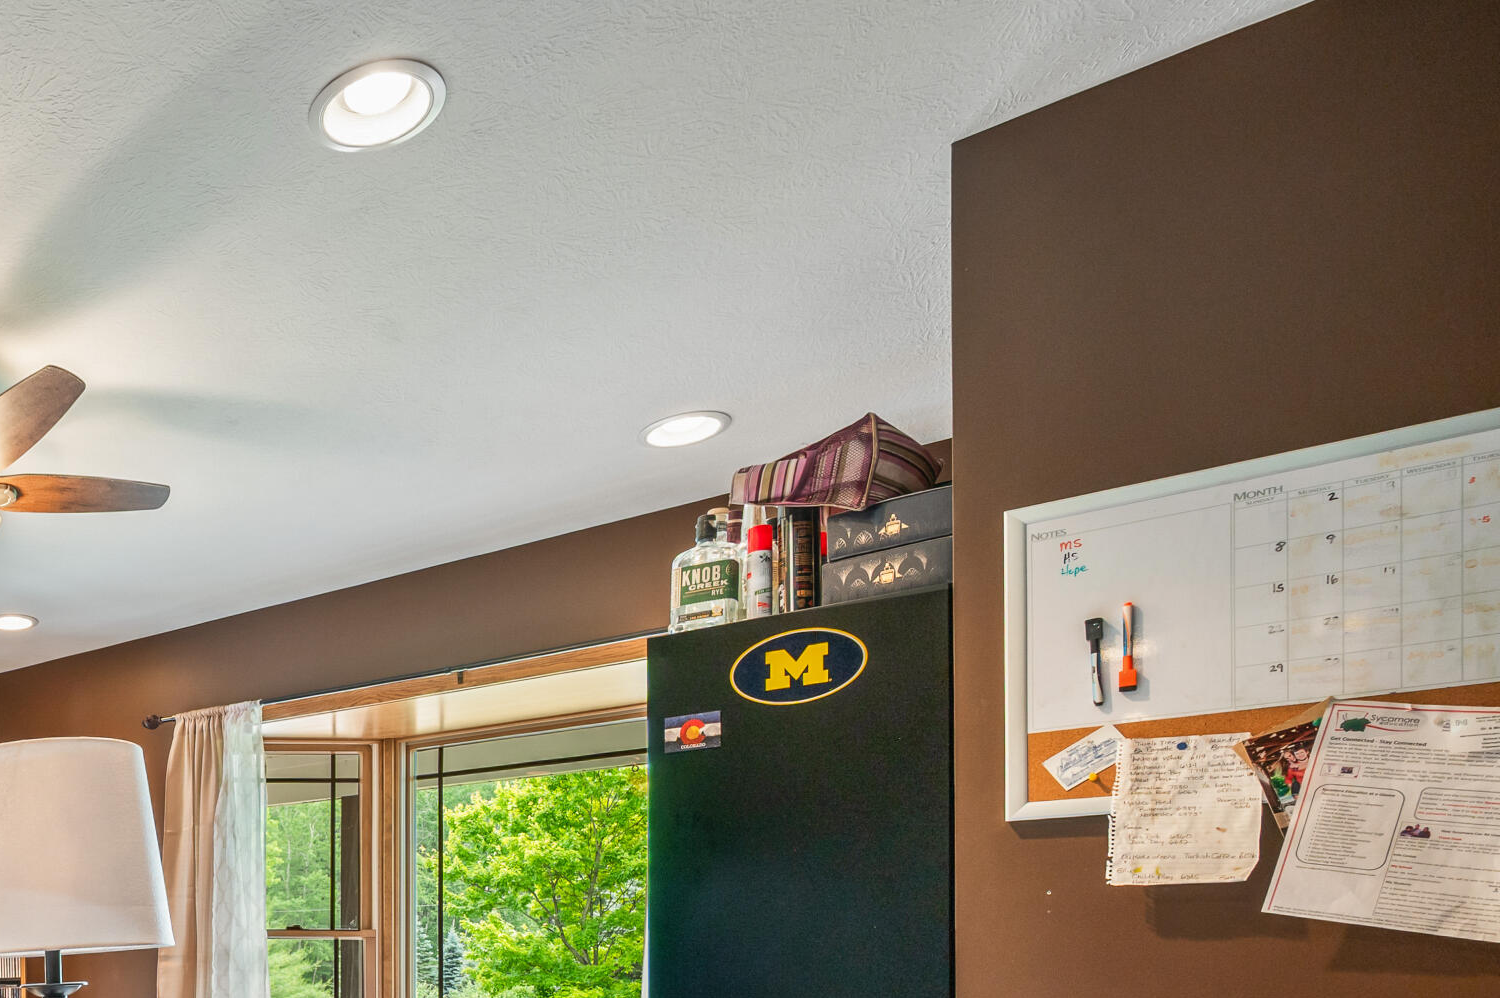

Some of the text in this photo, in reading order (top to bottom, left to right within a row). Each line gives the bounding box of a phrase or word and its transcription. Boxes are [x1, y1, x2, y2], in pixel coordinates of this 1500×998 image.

[1233, 485, 1284, 502] MONTH
[1328, 492, 1339, 502] 2
[1031, 529, 1067, 542] NOTES
[1275, 541, 1287, 552] 8
[681, 564, 721, 587] KNOB
[1326, 574, 1339, 585] 16
[688, 578, 729, 591] CREEK
[1272, 583, 1285, 593] 15
[711, 588, 724, 596] RYE
[764, 641, 830, 692] M
[1370, 714, 1420, 724] Sycamore
[1342, 736, 1375, 744] Connected
[1394, 739, 1428, 747] Connected
